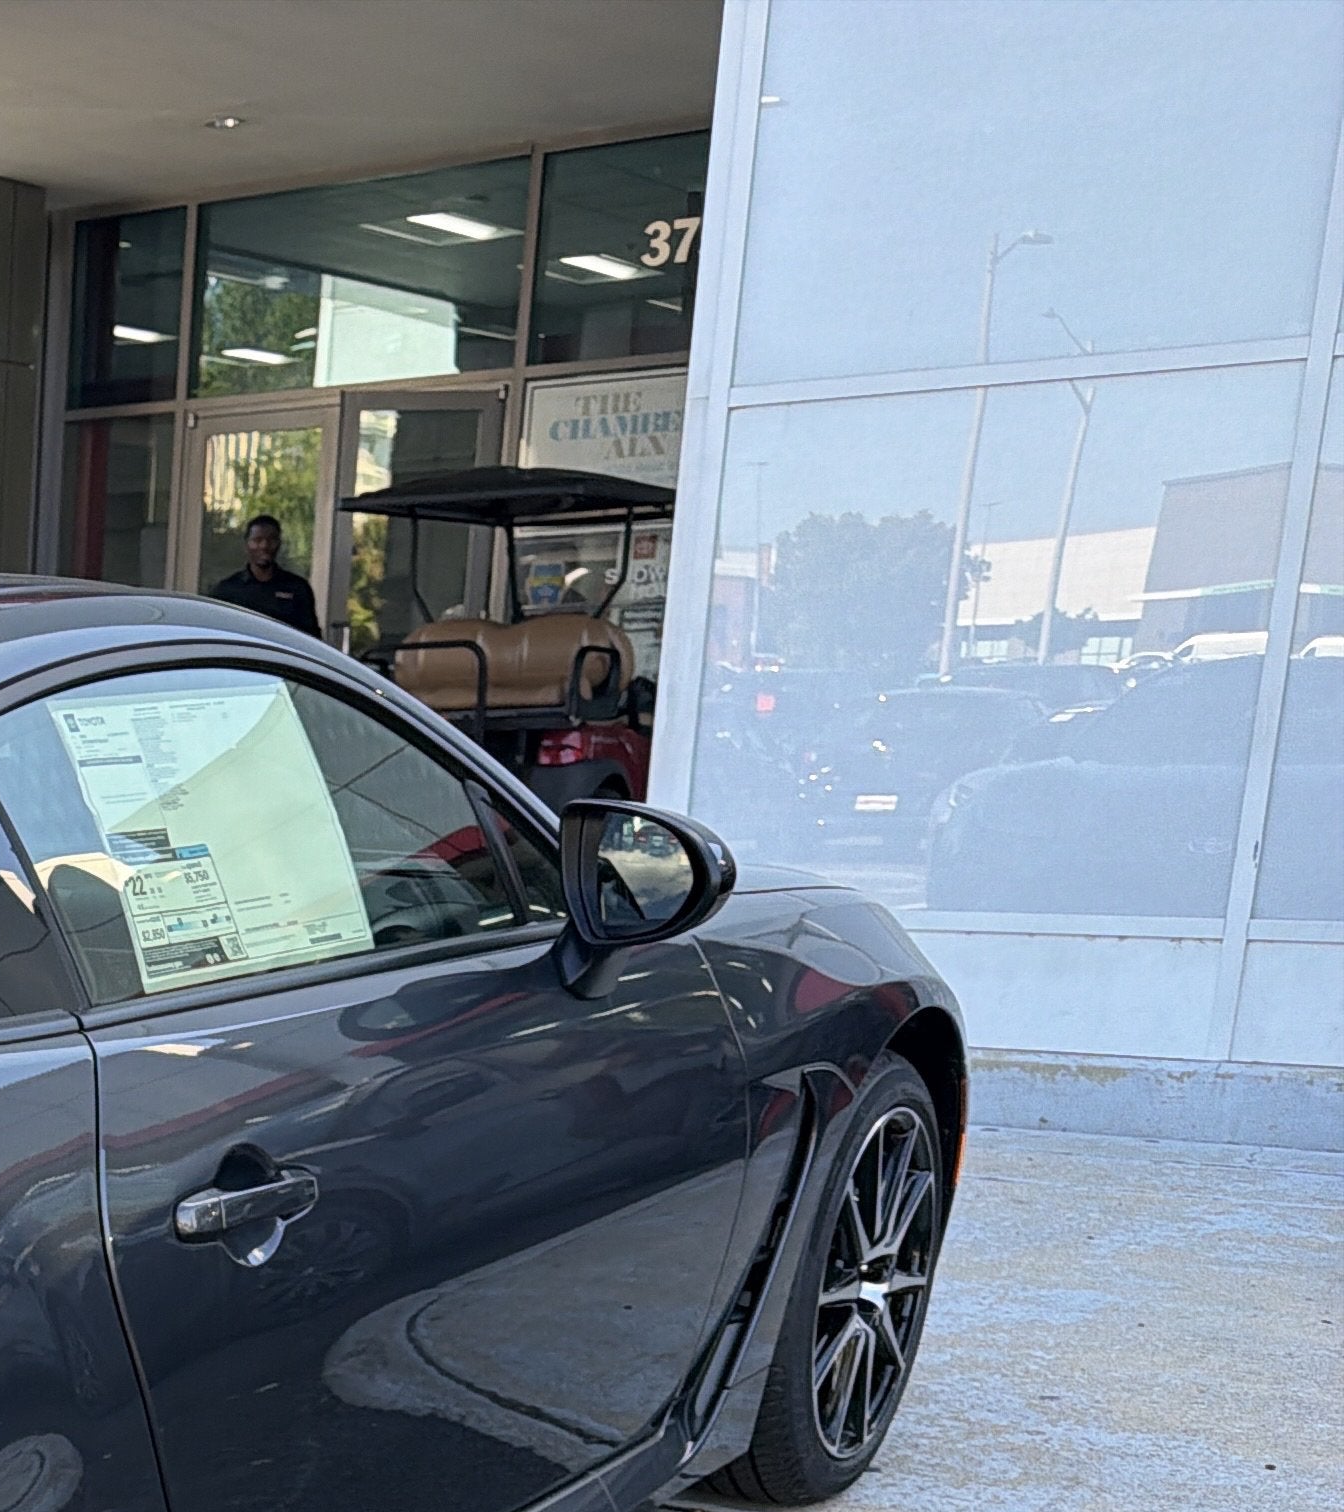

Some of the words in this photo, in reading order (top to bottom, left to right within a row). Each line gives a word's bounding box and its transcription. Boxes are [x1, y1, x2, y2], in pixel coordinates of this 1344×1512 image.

[640, 216, 701, 267] 37
[575, 391, 642, 417] THE
[548, 410, 682, 441] CHAMBE
[128, 875, 148, 897] 22
